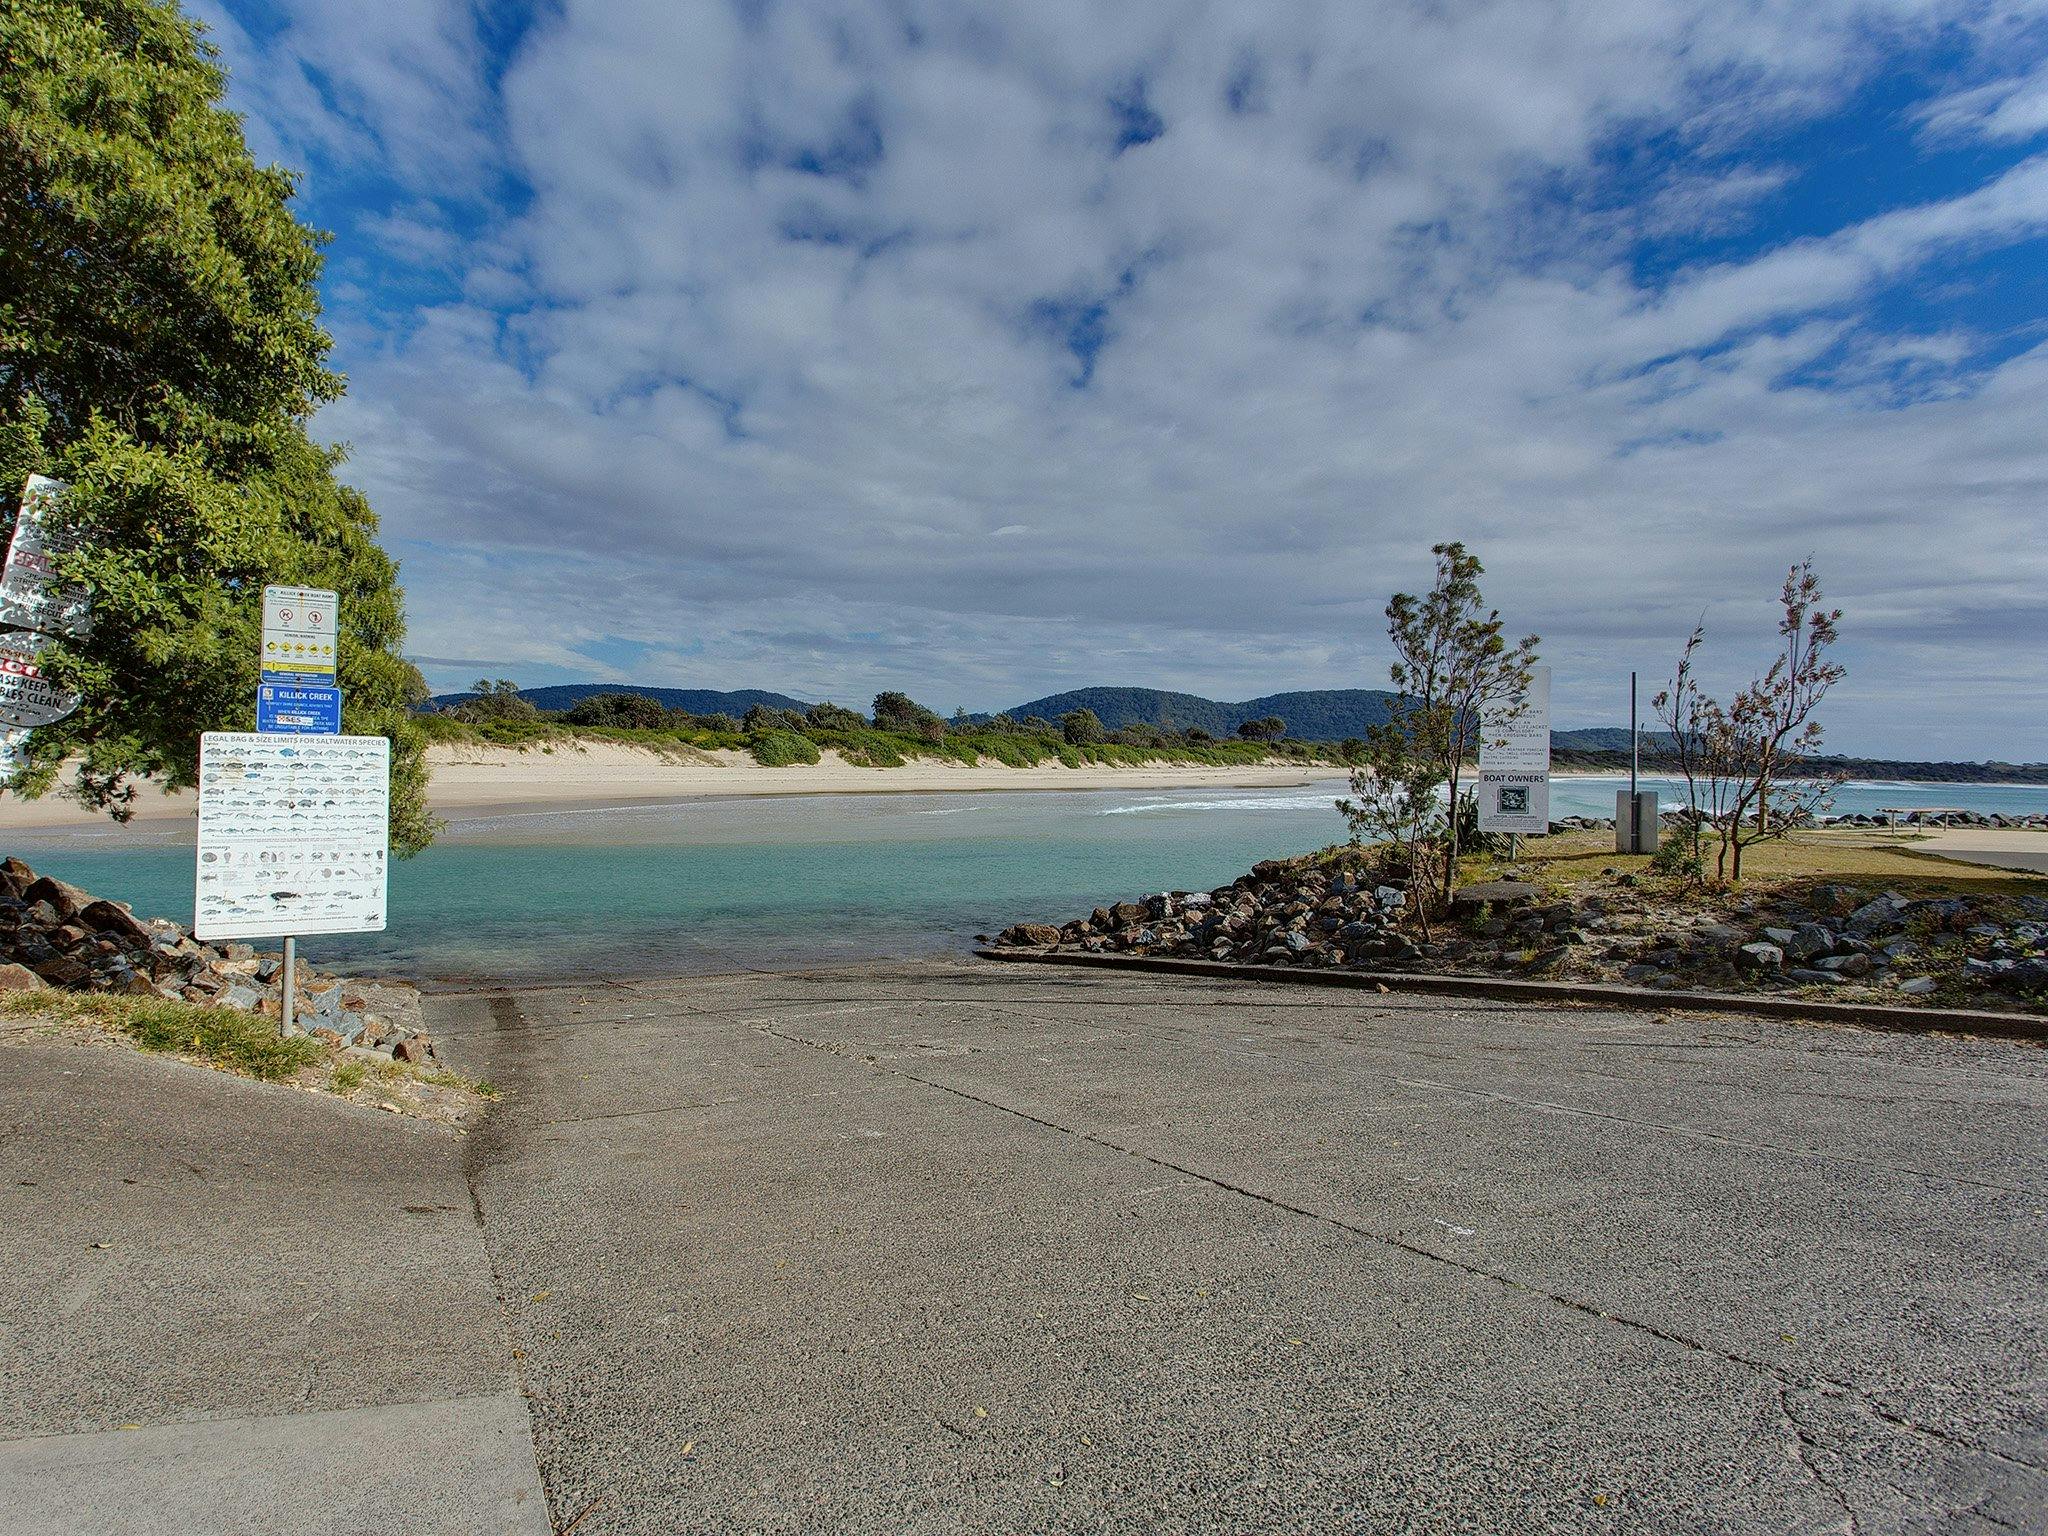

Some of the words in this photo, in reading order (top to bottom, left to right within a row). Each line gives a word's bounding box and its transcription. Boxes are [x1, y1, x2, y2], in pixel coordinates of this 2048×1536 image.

[21, 678, 48, 692] KEEP
[28, 693, 62, 709] CLEAN
[279, 690, 308, 699] KILLICK
[308, 692, 333, 701] CREEK
[204, 735, 229, 743] LEGAL
[231, 735, 248, 743] BAG
[273, 736, 299, 744] LIMITS
[316, 738, 358, 746] SALTWATER
[358, 739, 386, 747] SPECIES
[1483, 774, 1506, 782] BOAT
[1507, 775, 1545, 783] OWNERS
